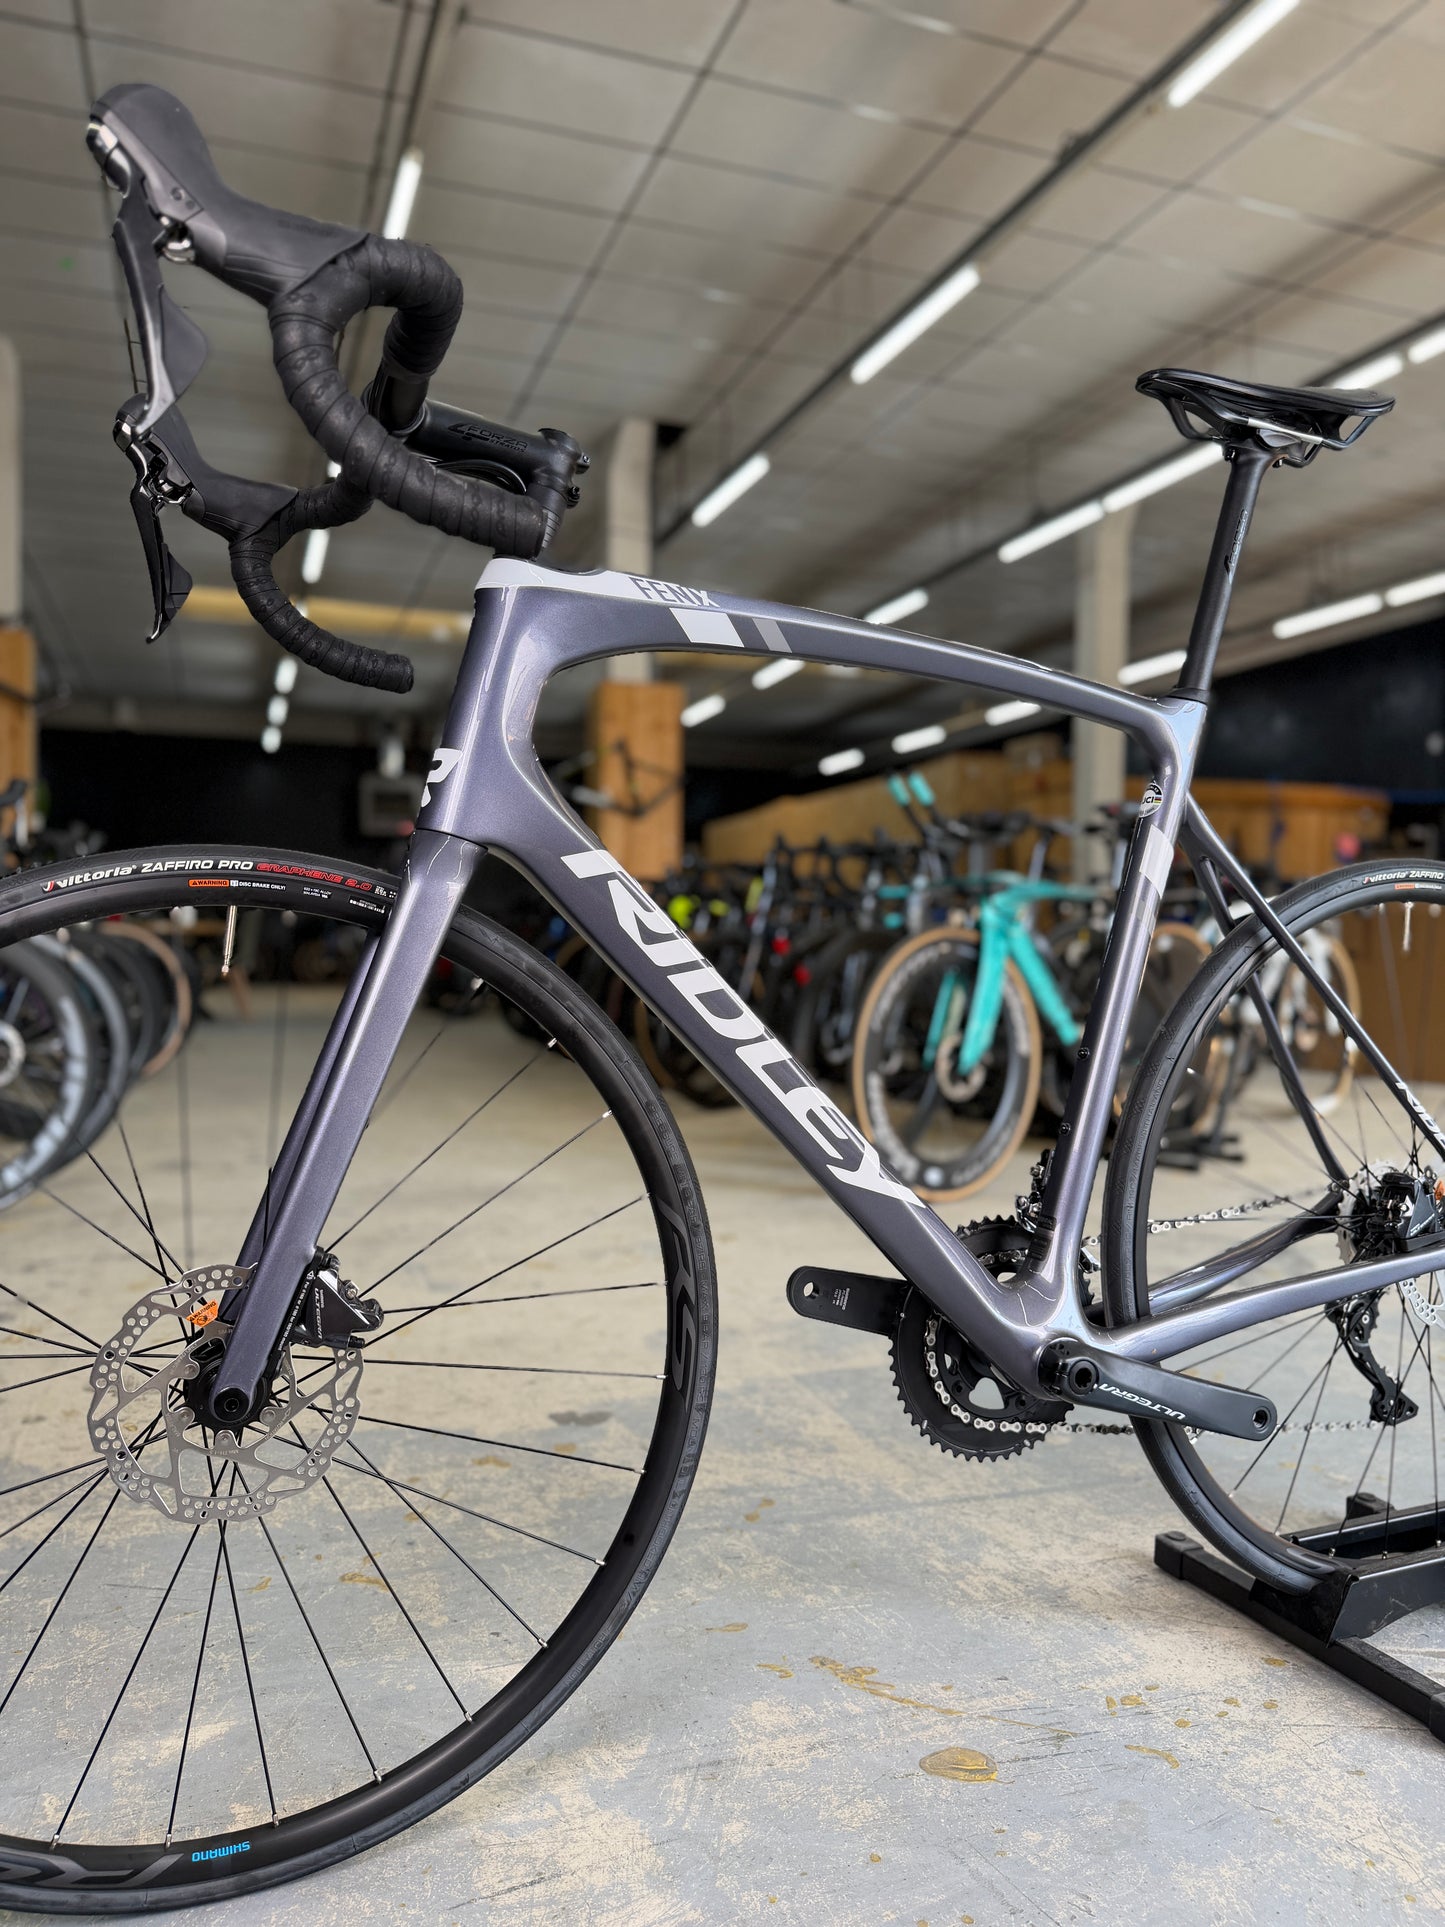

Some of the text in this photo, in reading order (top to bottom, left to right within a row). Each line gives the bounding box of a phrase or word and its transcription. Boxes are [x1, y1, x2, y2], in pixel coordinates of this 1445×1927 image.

[466, 424, 529, 449] FORZA
[628, 576, 721, 608] FENIX
[55, 866, 132, 889] vittoria
[141, 860, 214, 873] ZAFFIRO
[217, 859, 254, 871] PRO
[256, 862, 344, 884] GRAPHENE
[345, 878, 374, 892] 2.0
[252, 881, 270, 889] BRAKE
[1369, 871, 1407, 883] vittoria
[560, 849, 927, 1209] RIDLEY
[314, 1287, 323, 1340] ULTEGRA
[657, 1196, 696, 1413] RS
[1098, 1383, 1186, 1420] ULTEGRA
[191, 1840, 250, 1863] SHIMANO
